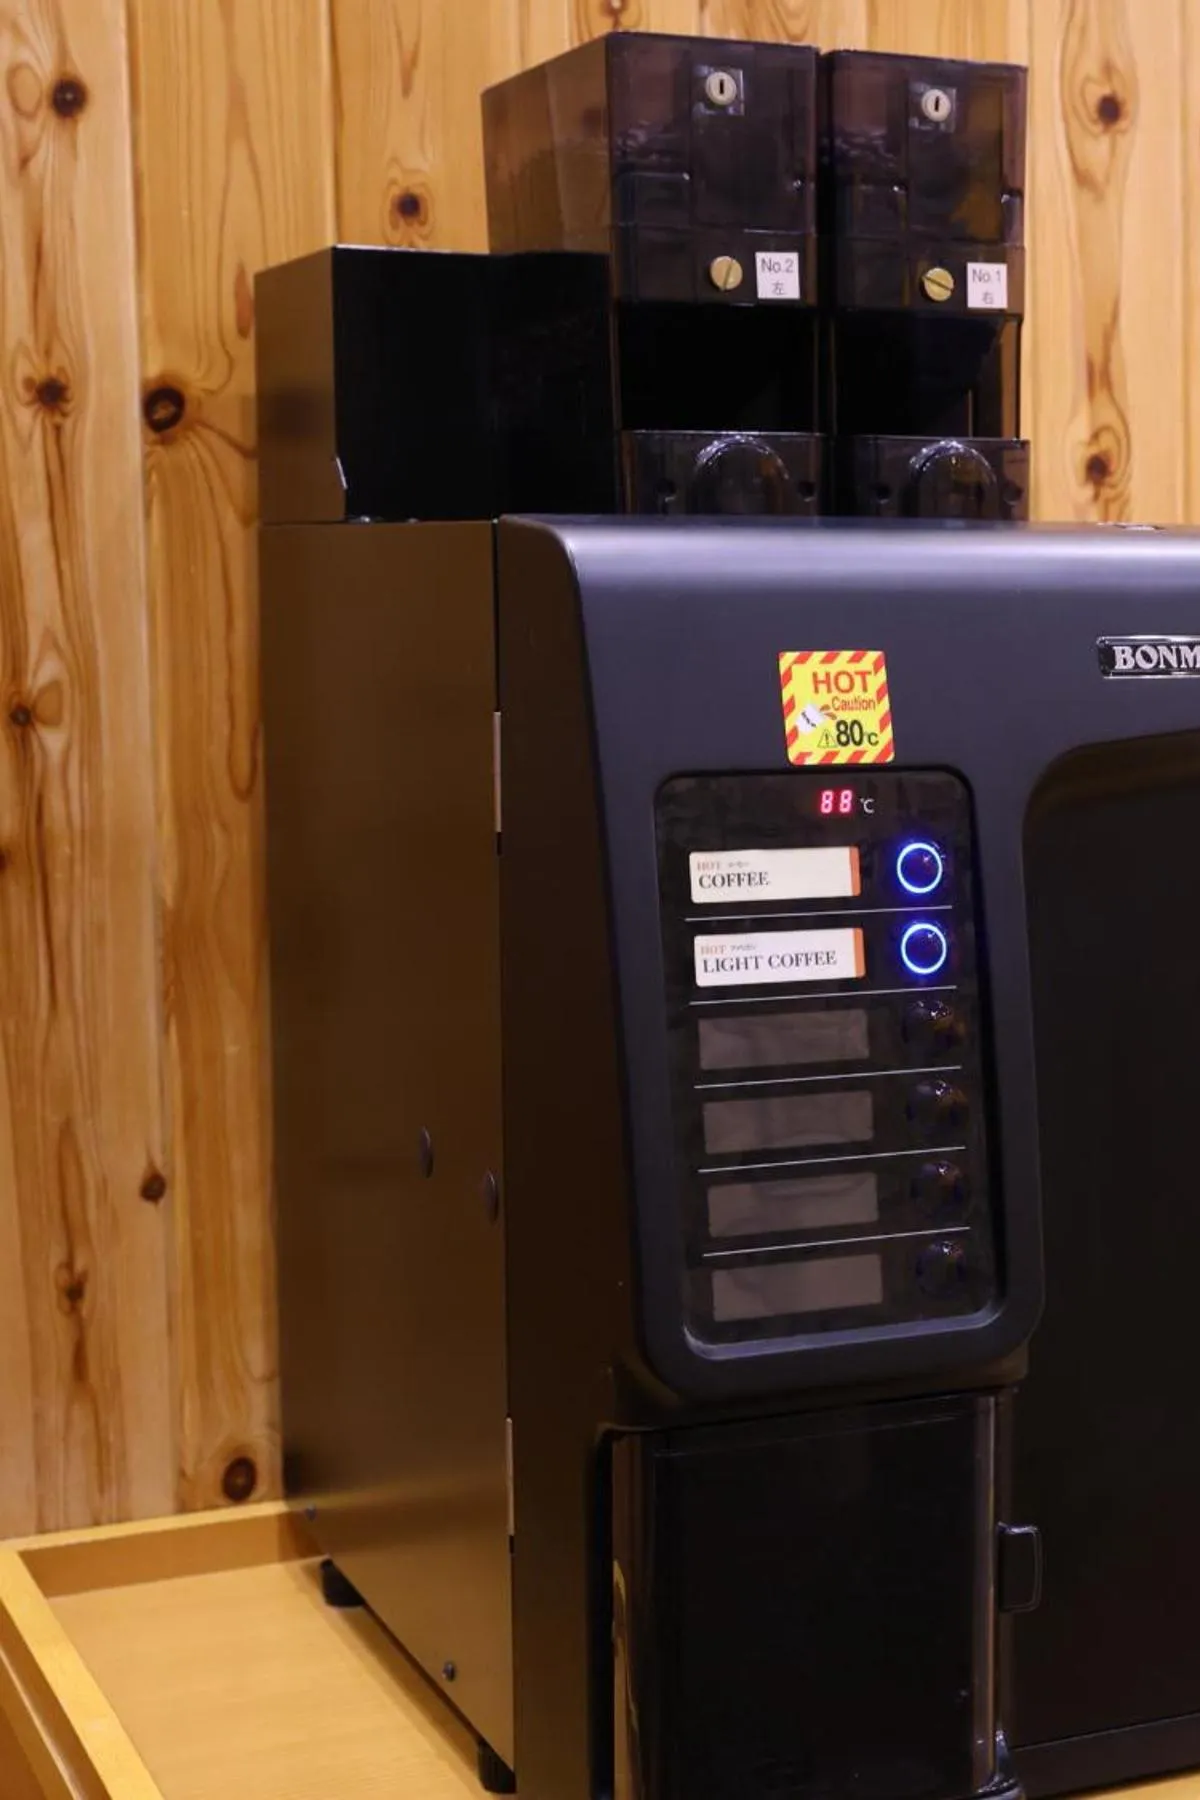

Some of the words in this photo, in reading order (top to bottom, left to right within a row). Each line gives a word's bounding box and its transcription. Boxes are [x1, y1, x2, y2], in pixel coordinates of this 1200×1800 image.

[761, 257, 794, 274] No.2
[972, 268, 1001, 284] No.1
[772, 281, 785, 296] 左
[812, 670, 872, 694] HOT
[831, 696, 877, 712] Caution
[820, 789, 853, 814] 88
[698, 871, 770, 890] COFFEE
[701, 944, 727, 956] HOT
[703, 955, 763, 974] LIGHT
[767, 950, 838, 970] COFFEE
